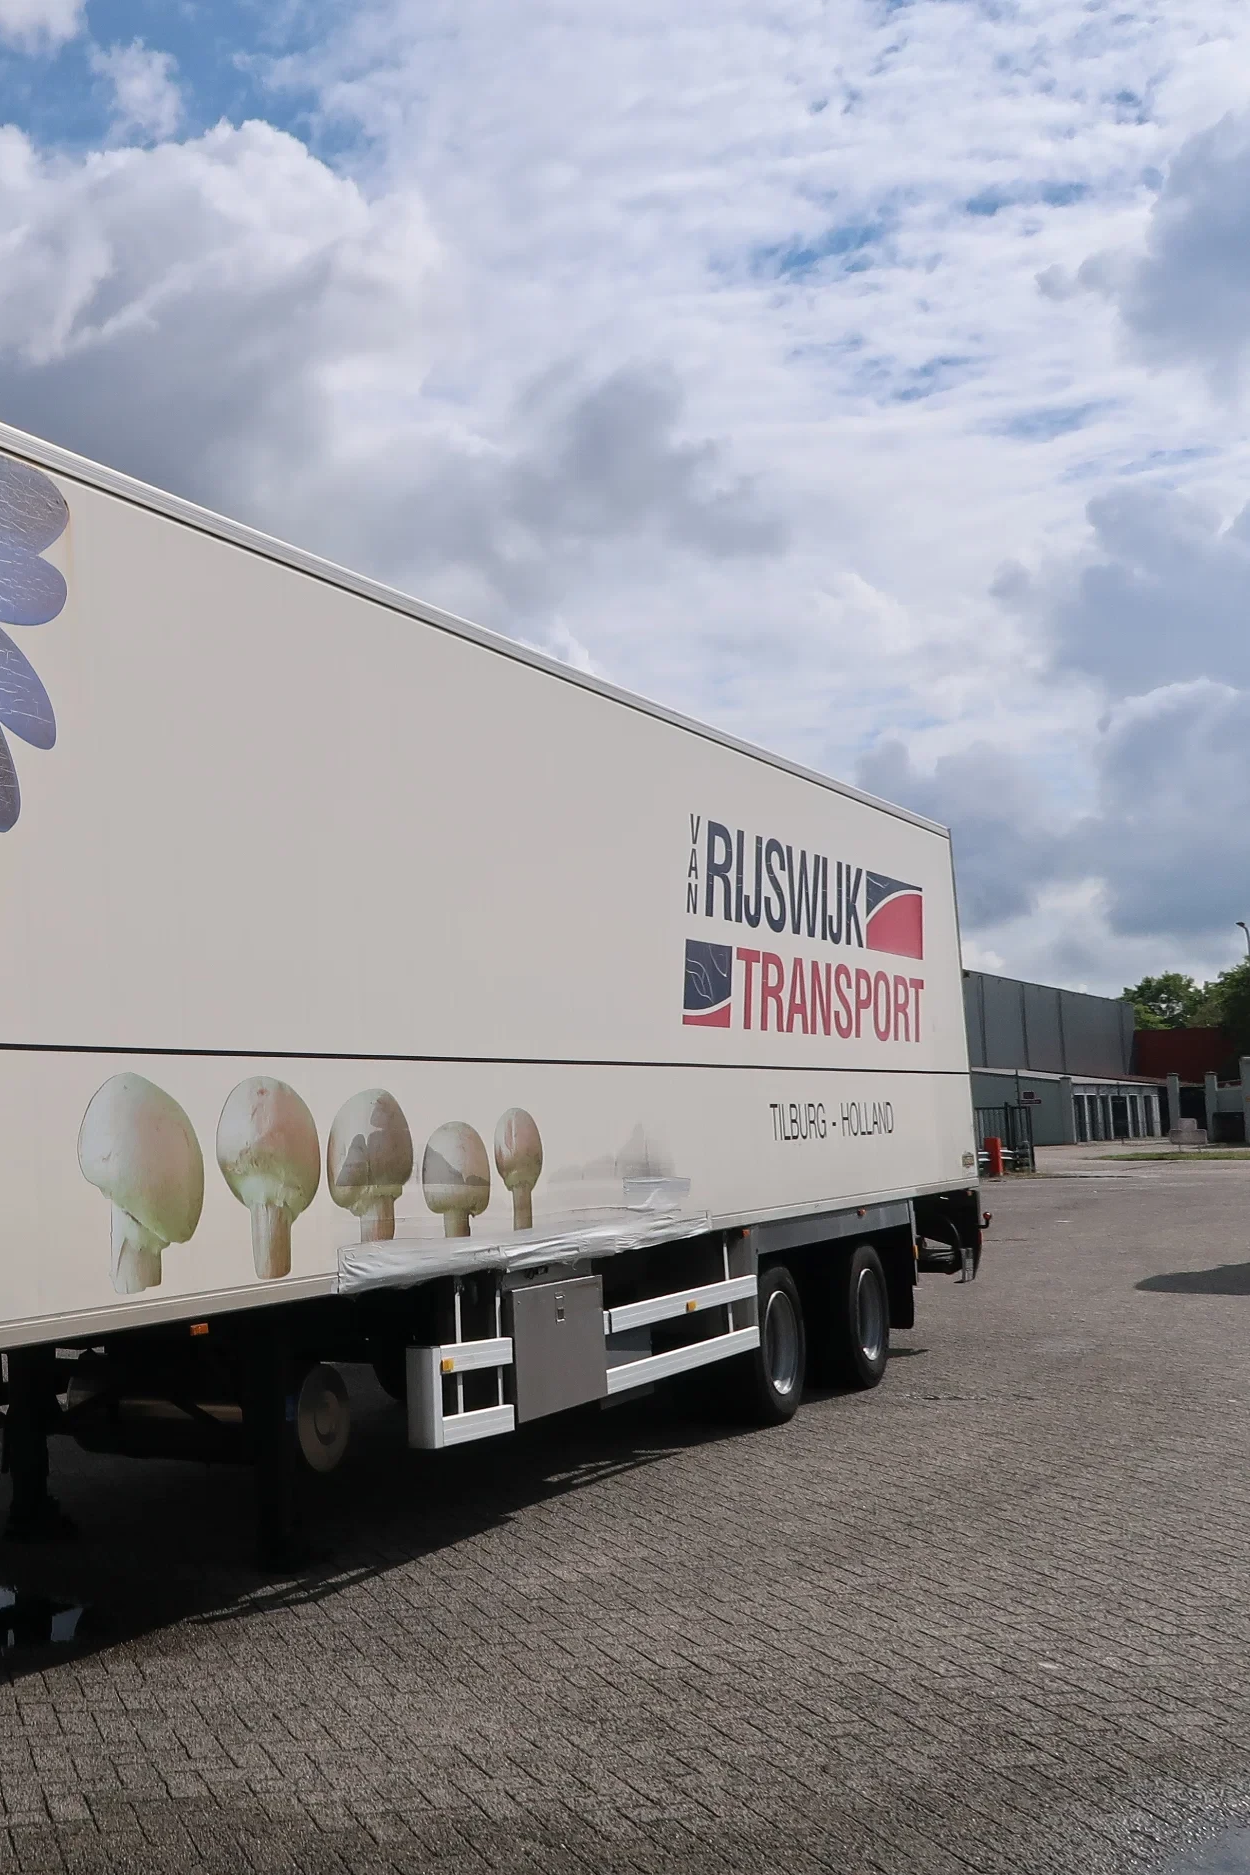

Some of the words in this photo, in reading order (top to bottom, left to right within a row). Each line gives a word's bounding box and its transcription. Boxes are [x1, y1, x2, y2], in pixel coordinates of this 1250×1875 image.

[686, 813, 701, 915] VAN
[705, 820, 864, 949] RIJSWIJK
[736, 946, 925, 1043] TRANSPORT
[769, 1102, 827, 1141] TILBURG
[840, 1101, 895, 1137] HOLLAND
